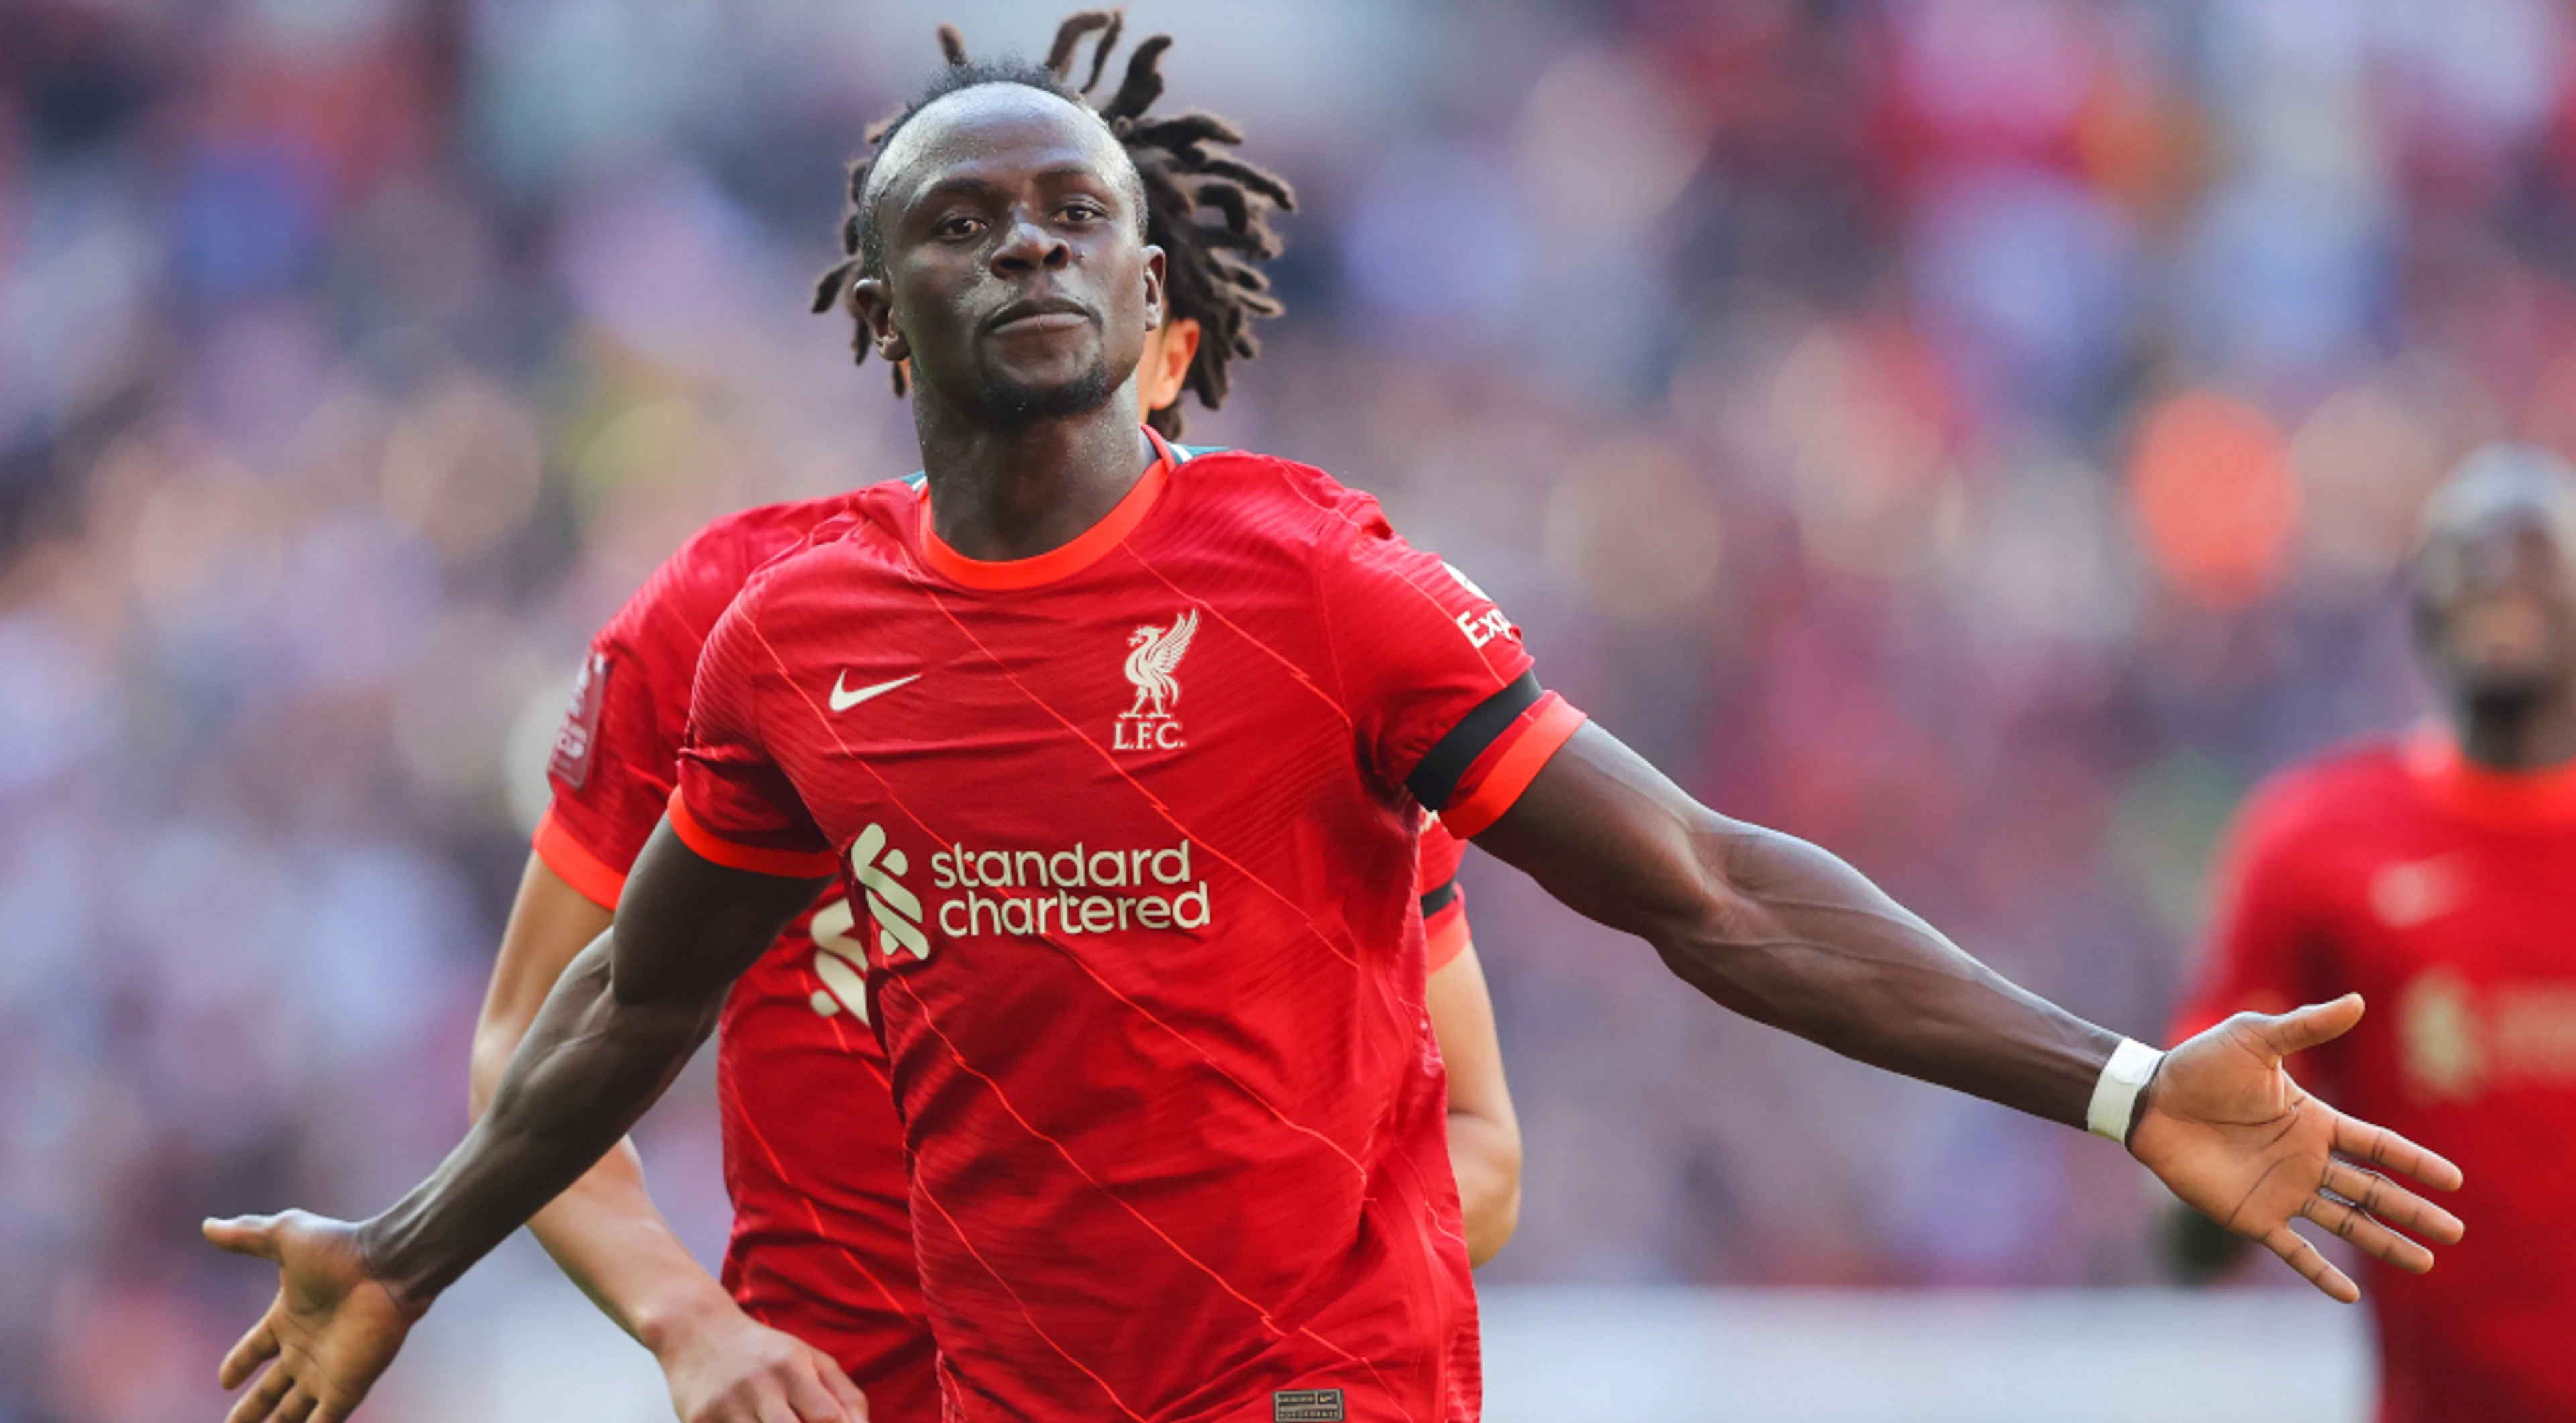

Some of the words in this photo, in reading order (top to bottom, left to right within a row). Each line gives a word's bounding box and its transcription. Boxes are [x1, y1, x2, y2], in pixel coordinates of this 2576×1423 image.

[1113, 721, 1185, 750] L.F.C.
[931, 839, 1190, 889] standard
[939, 881, 1210, 937] chartered
